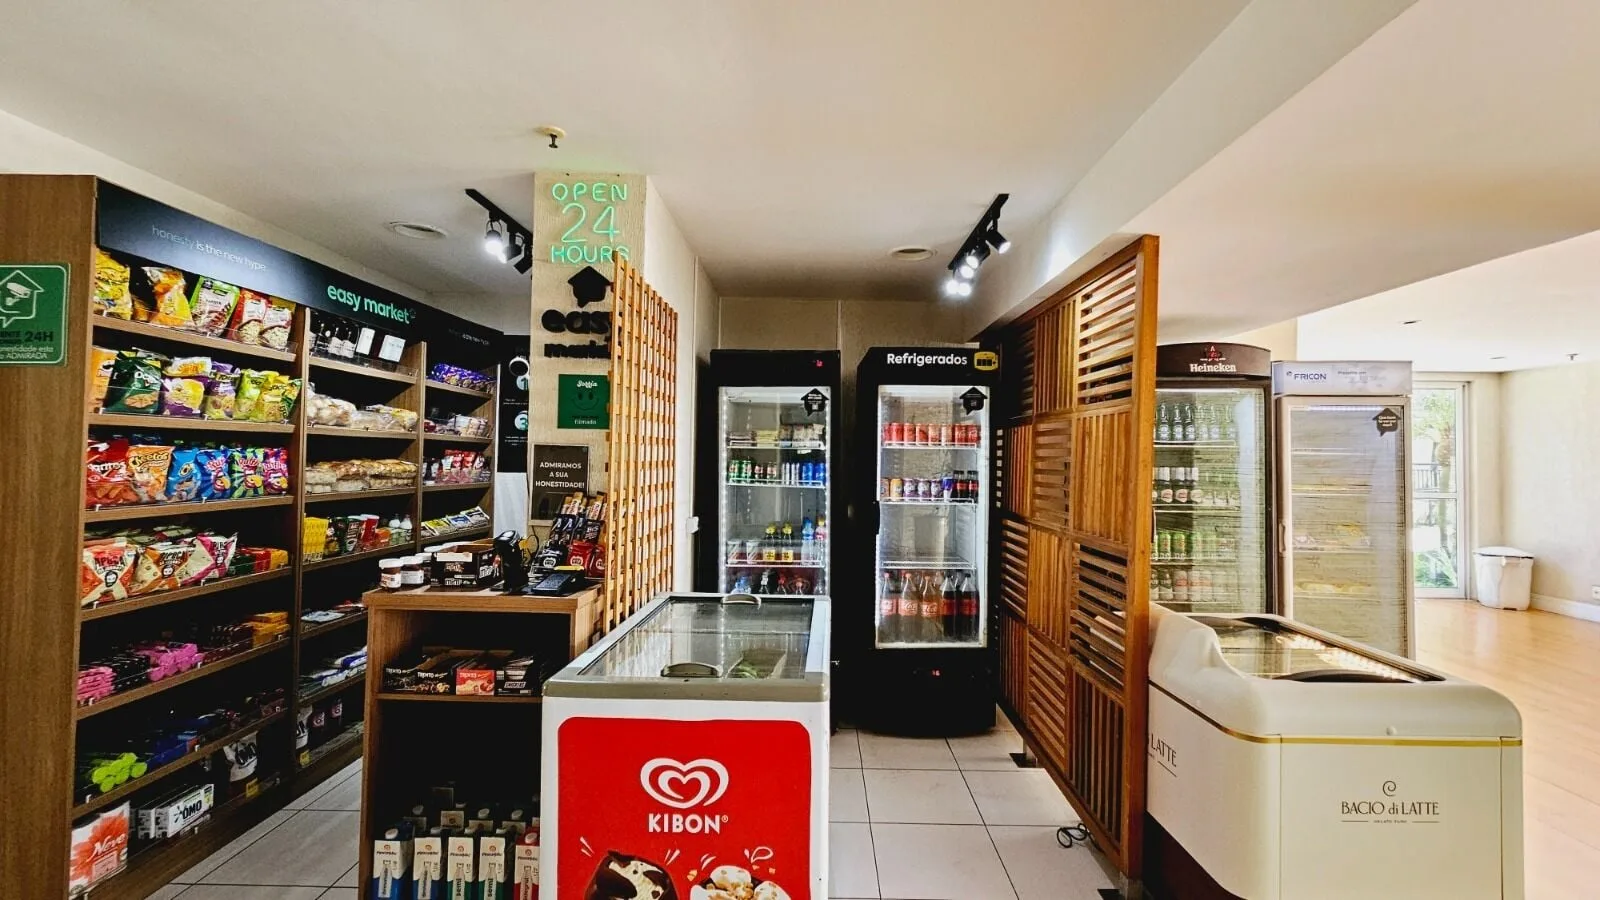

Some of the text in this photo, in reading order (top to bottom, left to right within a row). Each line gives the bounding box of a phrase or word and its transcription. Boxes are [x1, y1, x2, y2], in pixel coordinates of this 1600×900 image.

[552, 182, 627, 201] OPEN
[561, 203, 620, 243] 24
[152, 224, 266, 272] honesty is the new hype
[327, 285, 410, 324] easy market
[25, 331, 53, 342] 24H
[7, 352, 48, 360] ADMIRADA
[887, 353, 968, 367] Refrigerados
[1189, 362, 1237, 373] Heineken
[1294, 373, 1327, 381] FRICON
[129, 452, 168, 469] Cheetos
[535, 481, 585, 489] HONESTIDADE!
[1151, 733, 1177, 767] LATTE
[183, 799, 202, 819] OMO
[1341, 801, 1440, 815] BACIO di LATTE
[648, 813, 721, 835] KIBON
